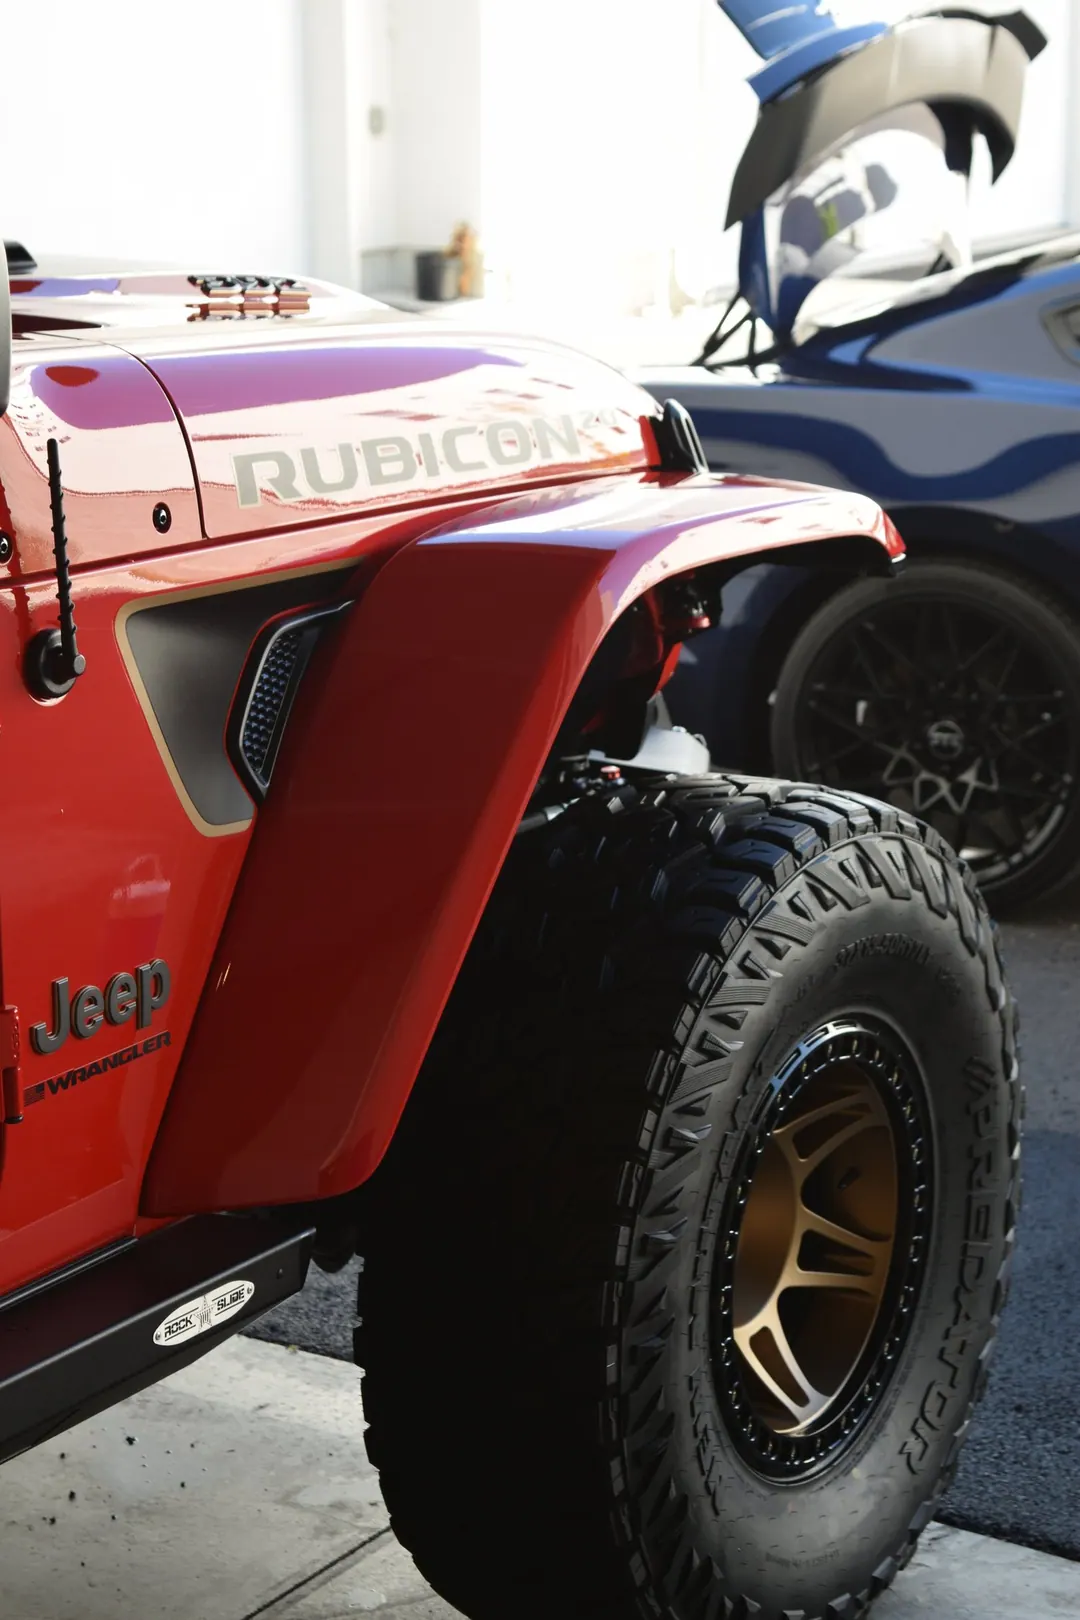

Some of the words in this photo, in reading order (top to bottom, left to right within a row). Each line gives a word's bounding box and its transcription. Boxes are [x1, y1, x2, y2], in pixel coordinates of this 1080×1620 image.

[232, 414, 582, 508] RUBICON
[30, 958, 171, 1055] Jeep
[46, 1033, 172, 1095] WRANGLER
[164, 1316, 193, 1338] ROCK
[216, 1287, 245, 1311] SLIDE
